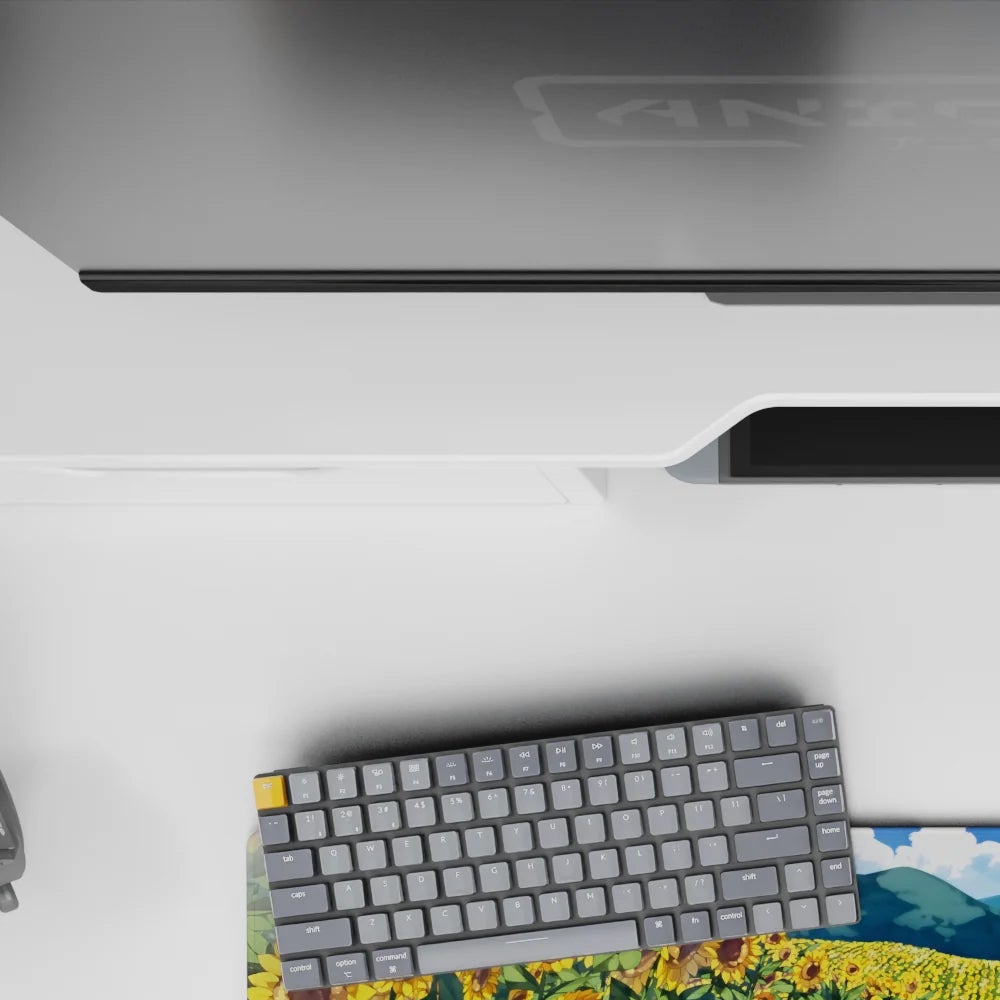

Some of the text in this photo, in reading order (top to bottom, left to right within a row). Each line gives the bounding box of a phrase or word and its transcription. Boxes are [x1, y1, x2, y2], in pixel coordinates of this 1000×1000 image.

[776, 720, 786, 728] del
[813, 752, 830, 760] page
[817, 789, 834, 797] page
[818, 797, 837, 805] down
[821, 826, 841, 835] home
[282, 854, 294, 863] tab
[829, 862, 842, 870] end
[742, 873, 757, 881] shift
[291, 891, 306, 899] caps
[720, 911, 743, 921] control
[306, 925, 320, 934] shift
[375, 952, 407, 962] command
[336, 958, 357, 968] option
[290, 963, 312, 972] control
